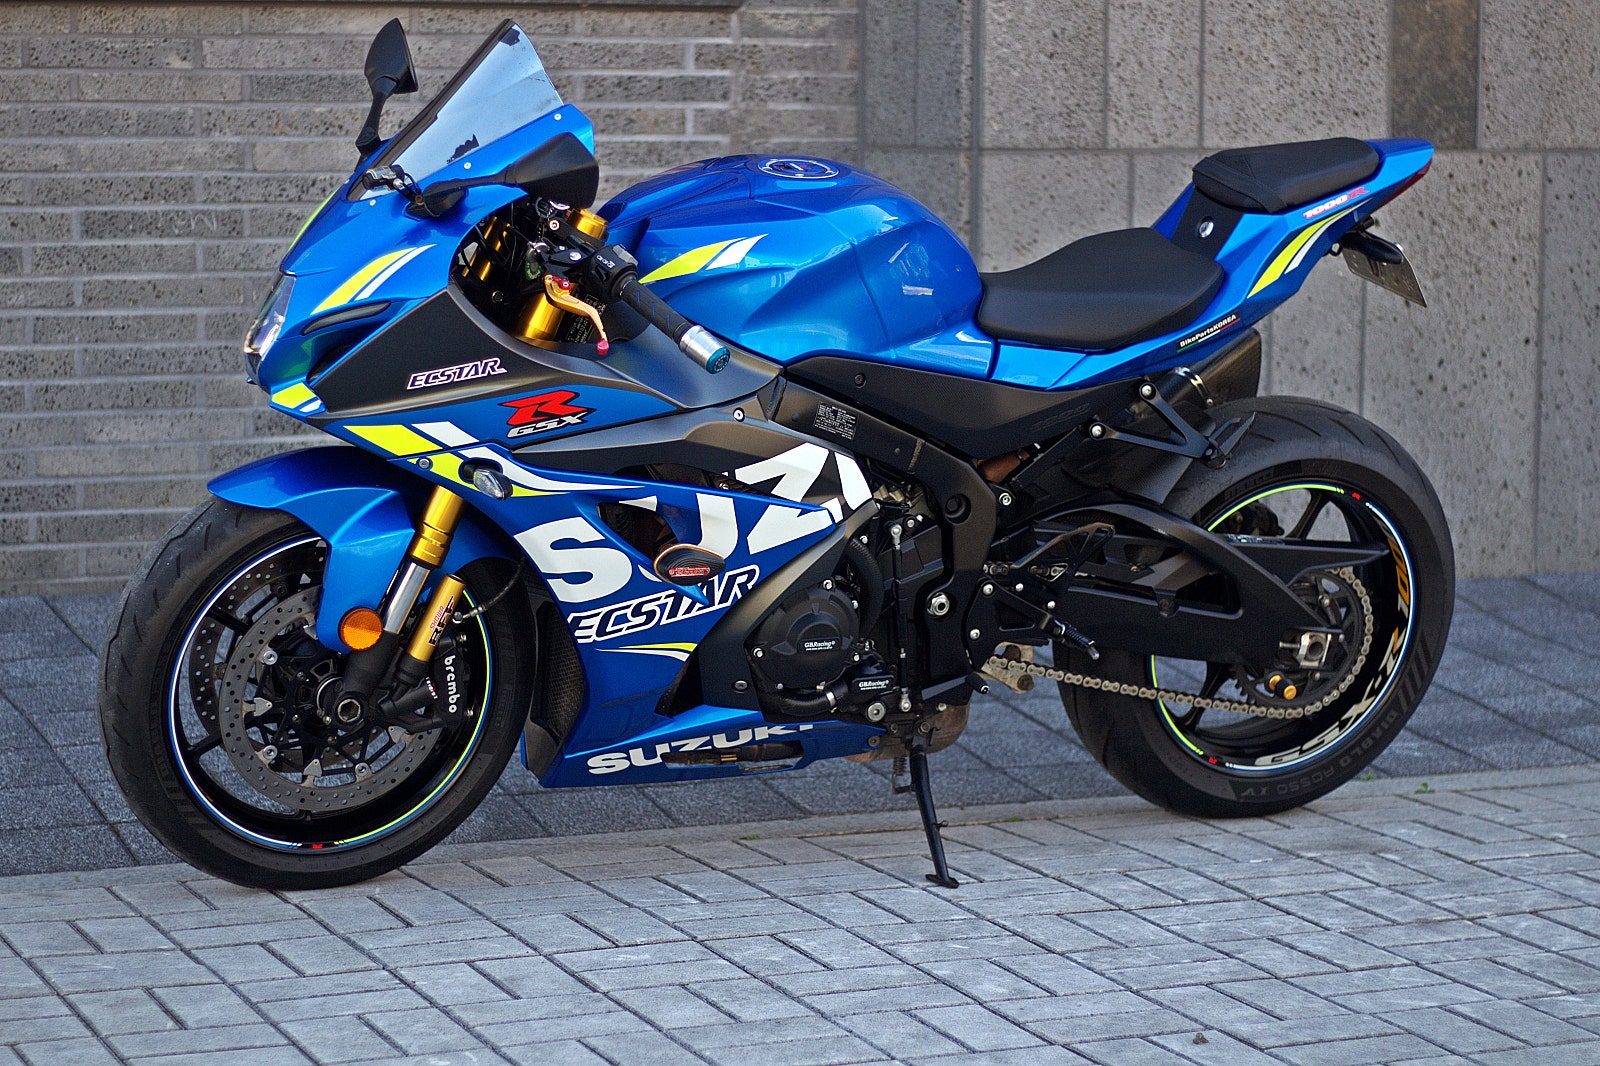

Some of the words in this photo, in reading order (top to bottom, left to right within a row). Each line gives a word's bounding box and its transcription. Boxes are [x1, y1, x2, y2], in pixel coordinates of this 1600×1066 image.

[1179, 314, 1237, 349] BikePartsKOREA
[406, 357, 508, 390] ECSTAR
[499, 390, 588, 426] R
[506, 411, 588, 439] GSX
[429, 605, 445, 630] SHOWA
[567, 564, 760, 643] ECSTAR
[444, 655, 462, 714] brembo
[1339, 709, 1398, 768] DIABLO
[1277, 768, 1336, 795] ROSSO
